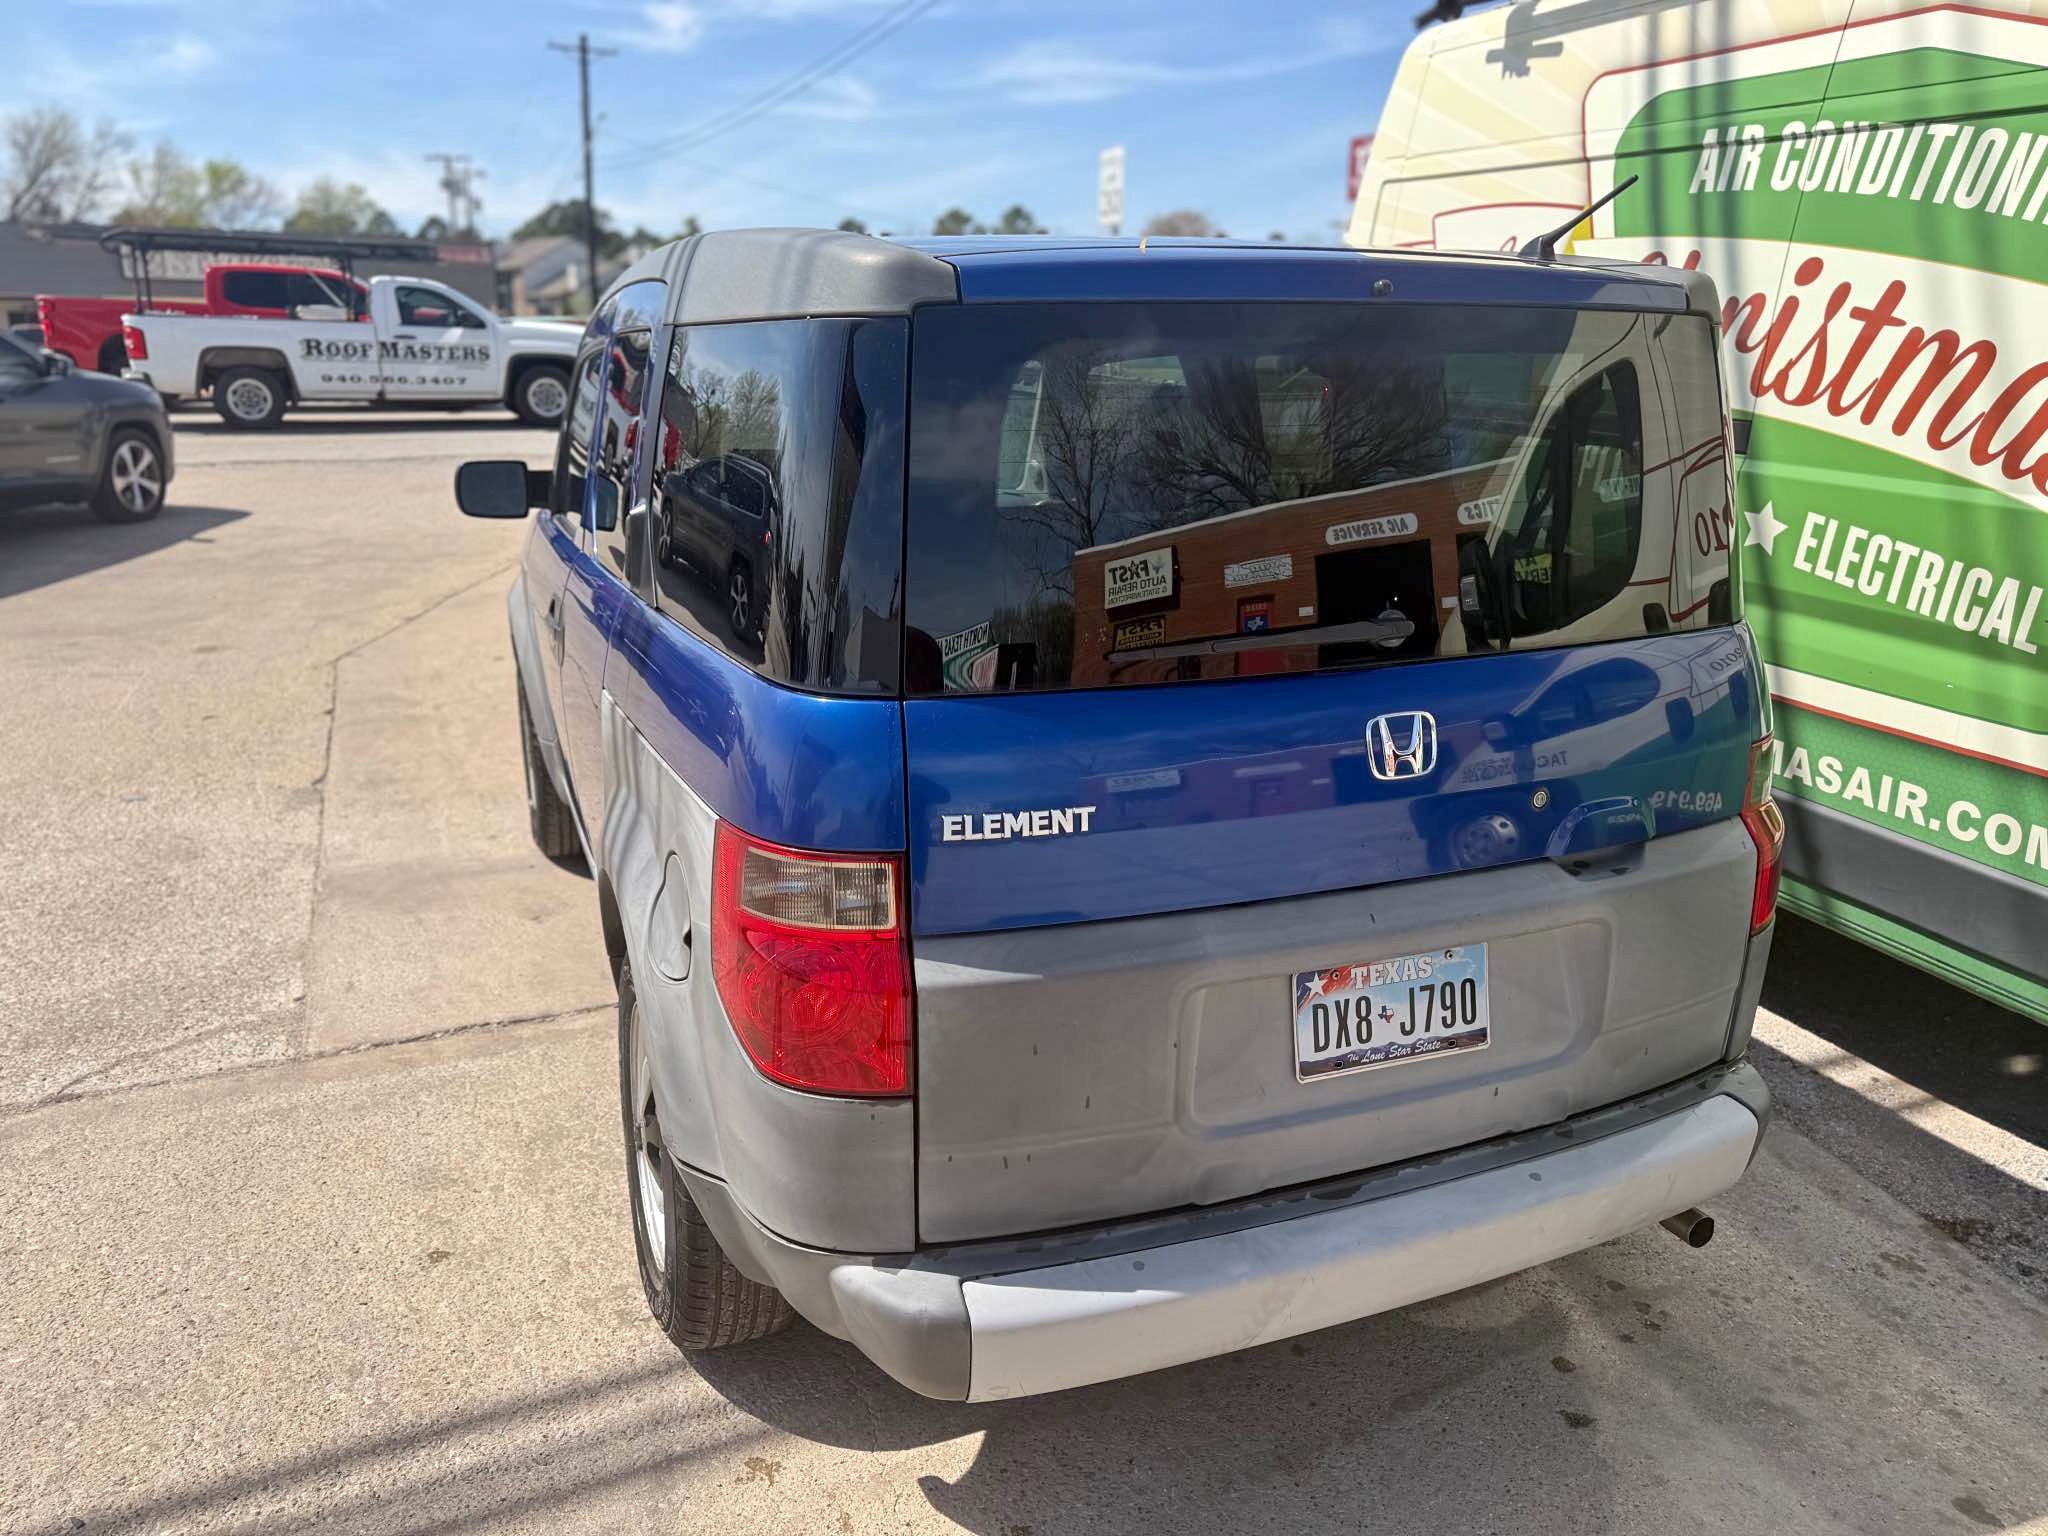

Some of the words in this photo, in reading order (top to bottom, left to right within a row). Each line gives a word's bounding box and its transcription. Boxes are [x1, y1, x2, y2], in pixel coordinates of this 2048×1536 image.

[1689, 123, 1766, 194] AIR
[1770, 120, 2048, 226] CONDITIONI
[377, 341, 491, 361] MASTERS
[1641, 250, 2048, 498] ristma
[1793, 511, 2044, 654] ELECTRICAL
[942, 806, 1097, 842] ELEMENT
[1350, 954, 1433, 990] TEXAS
[1312, 995, 1373, 1054] DX8
[1400, 977, 1477, 1037] J790
[1361, 1048, 1386, 1063] Lone
[1389, 1044, 1412, 1058] Star
[1415, 1039, 1441, 1052] State
